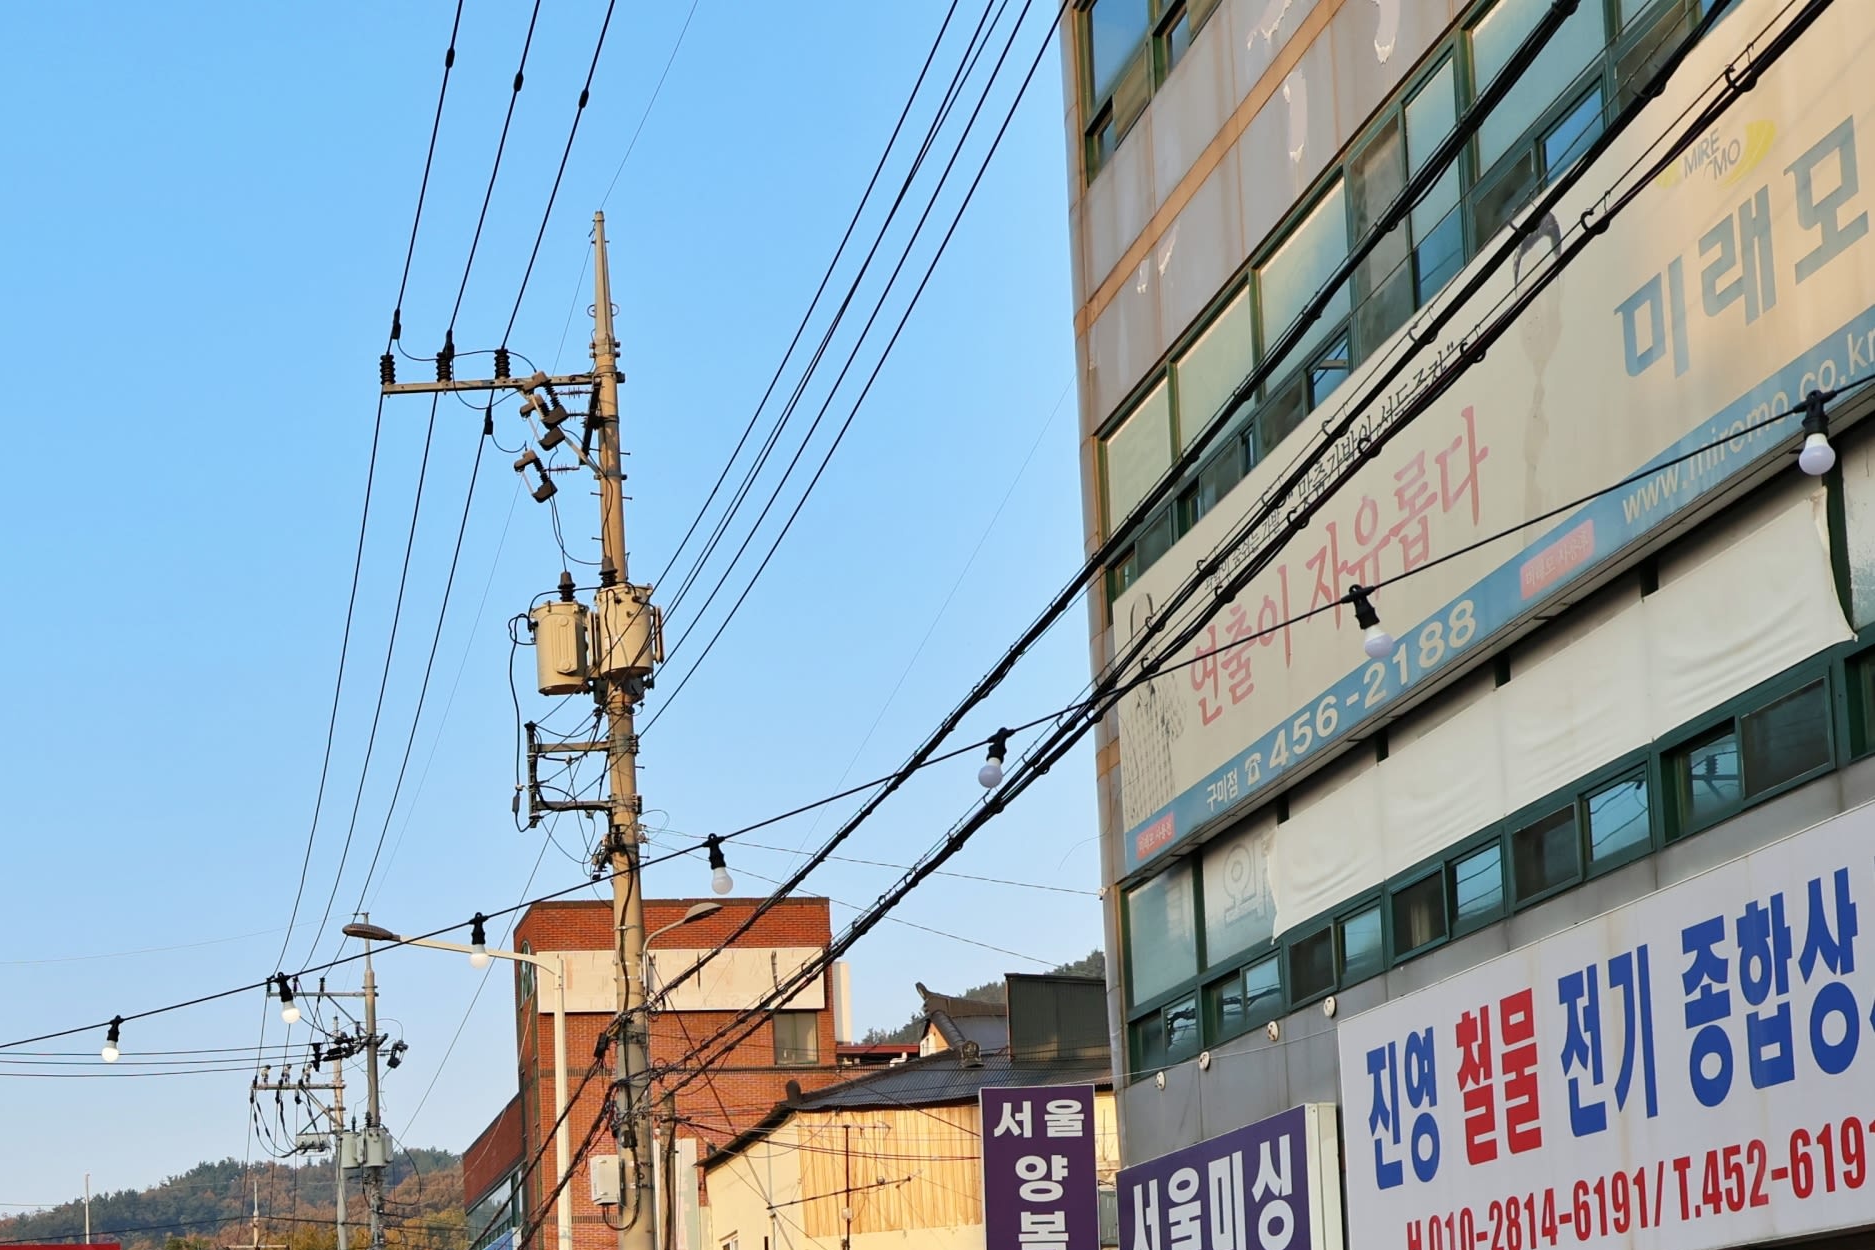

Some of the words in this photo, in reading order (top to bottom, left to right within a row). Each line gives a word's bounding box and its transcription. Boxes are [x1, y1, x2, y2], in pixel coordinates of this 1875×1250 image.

[1613, 114, 1870, 379] 미래모
[1682, 126, 1722, 181] MIRE
[1306, 404, 1489, 630] 자유롭다
[1206, 766, 1239, 813] 구미점
[1268, 599, 1478, 771] 456-2188
[993, 1098, 1085, 1139] 서울
[1366, 1025, 1441, 1191] 진영
[1455, 986, 1544, 1167] 철물
[1557, 942, 1660, 1139] 전기
[1681, 858, 1875, 1108] 종합상
